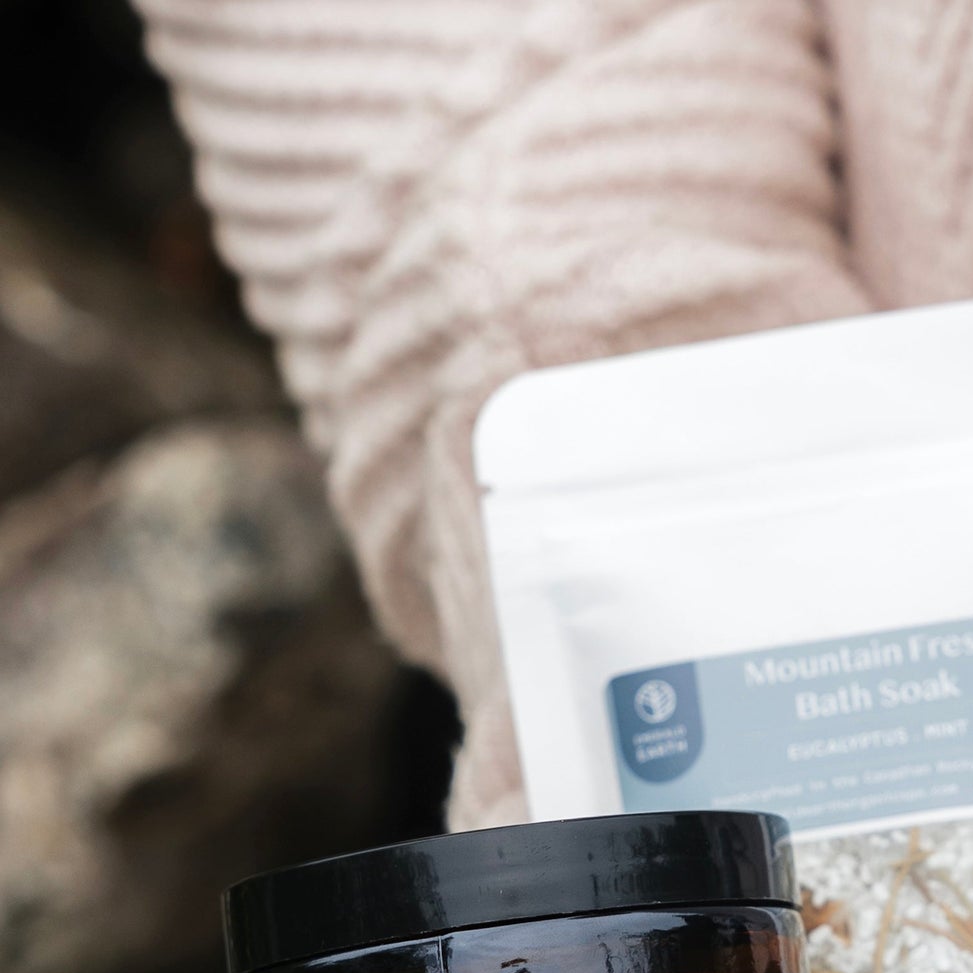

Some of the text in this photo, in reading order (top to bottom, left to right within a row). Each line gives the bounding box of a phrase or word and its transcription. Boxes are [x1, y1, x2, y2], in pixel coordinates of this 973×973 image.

[744, 639, 903, 686] Mountain
[795, 667, 962, 720] Bath Soak
[787, 727, 909, 761] EUCALYPTUS
[924, 718, 969, 741] MINT
